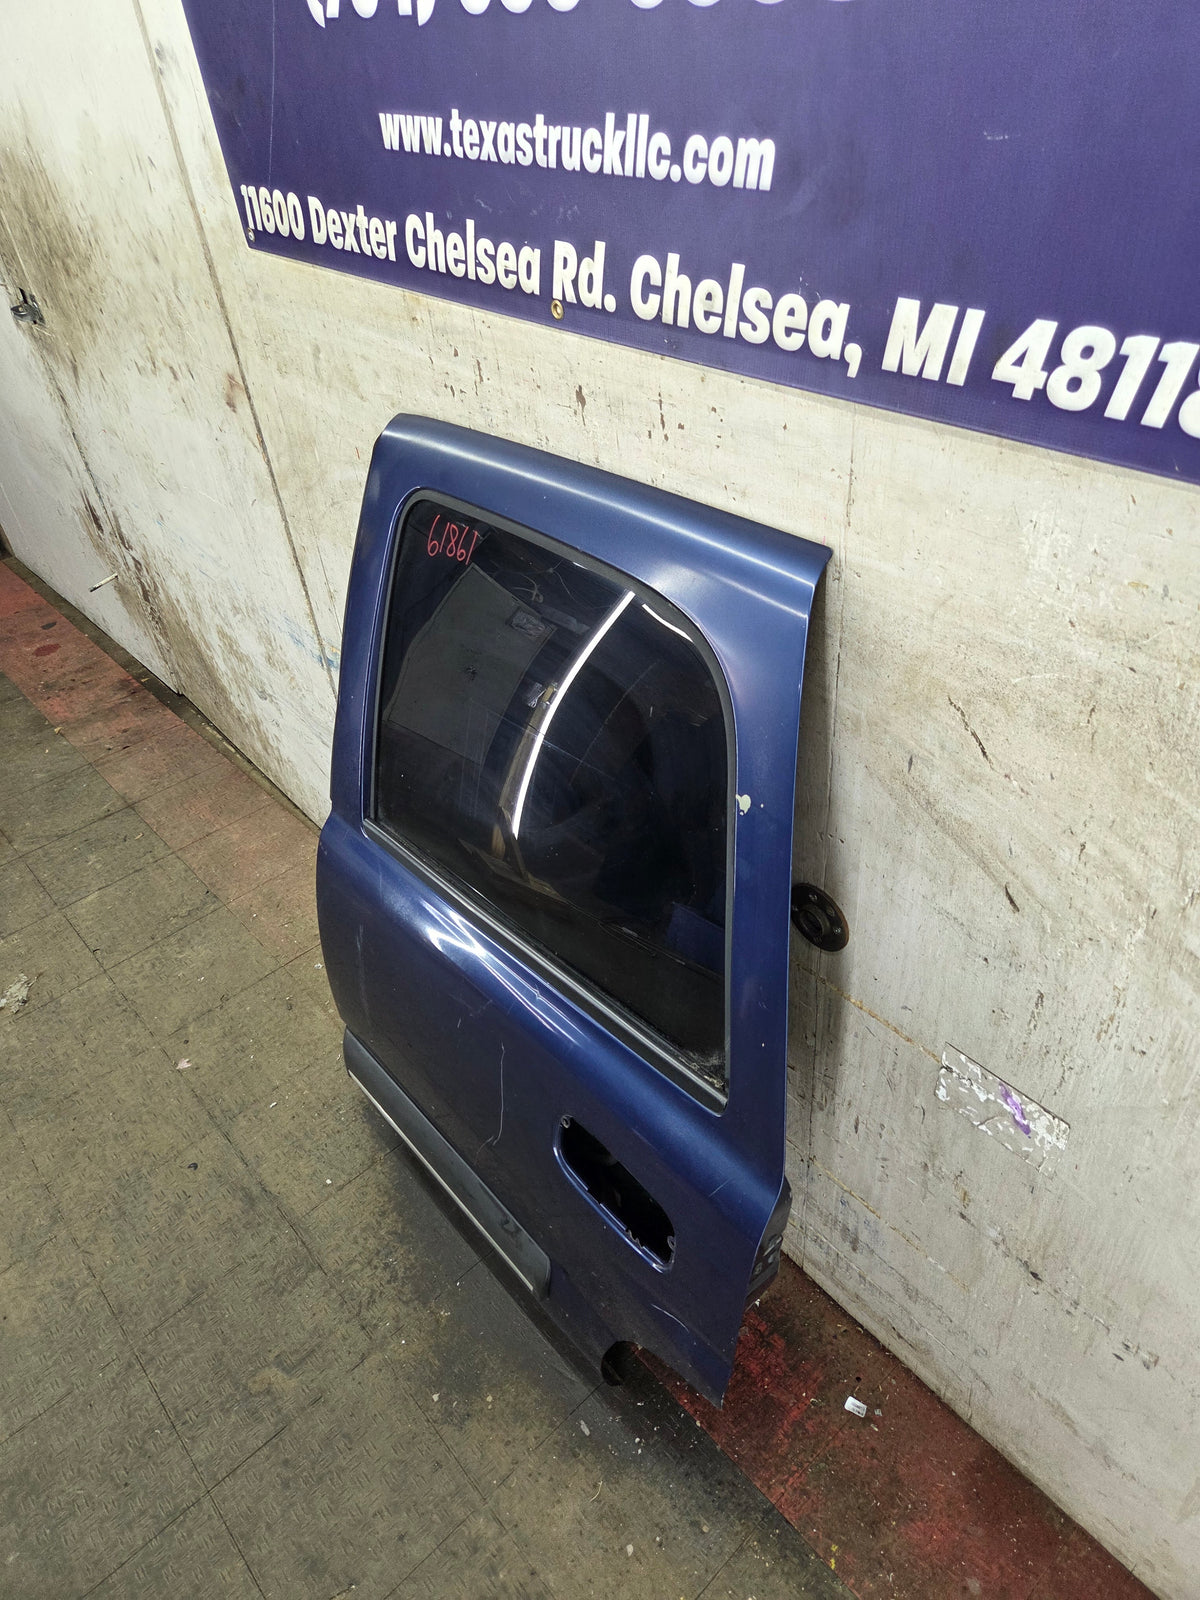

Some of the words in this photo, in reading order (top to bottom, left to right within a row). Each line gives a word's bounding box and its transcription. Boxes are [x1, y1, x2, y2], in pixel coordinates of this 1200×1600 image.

[378, 108, 777, 191] www.texastruckllc.com
[240, 184, 305, 241] 11600
[307, 195, 398, 262] Dexter
[404, 212, 542, 296] Chelsea
[552, 240, 617, 313] Rd.
[629, 252, 863, 379] Chelsea,
[881, 296, 986, 387] MI
